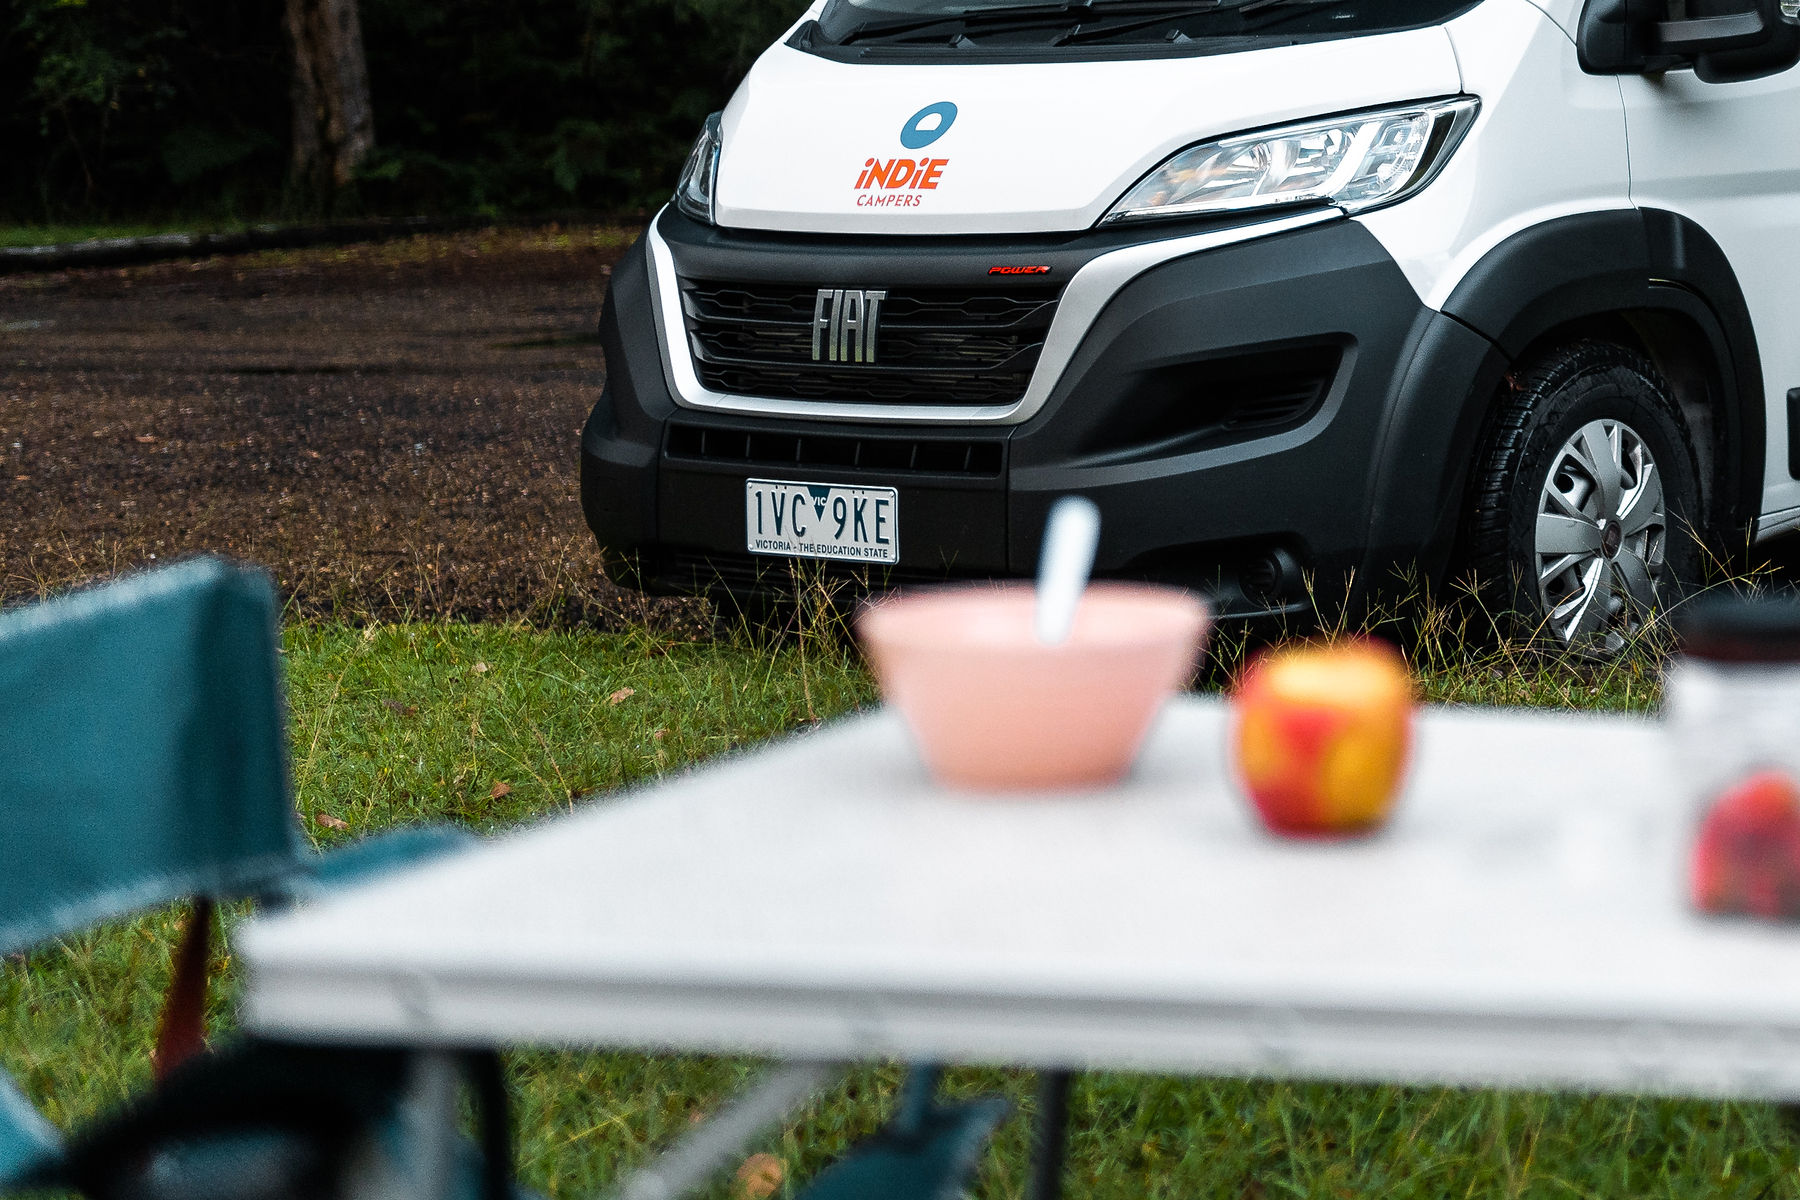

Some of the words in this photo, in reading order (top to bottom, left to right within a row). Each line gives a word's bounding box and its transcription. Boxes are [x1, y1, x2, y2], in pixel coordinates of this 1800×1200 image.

[857, 194, 922, 207] CAMPERS
[988, 265, 1050, 275] POWER
[812, 288, 888, 363] FIAT
[811, 496, 827, 506] VIC
[755, 490, 806, 537] 1VC
[833, 496, 889, 544] 9KE
[755, 539, 791, 550] VICTORIA
[799, 543, 814, 552] THE
[816, 544, 861, 556] EDUCATION
[863, 548, 888, 558] STATE
